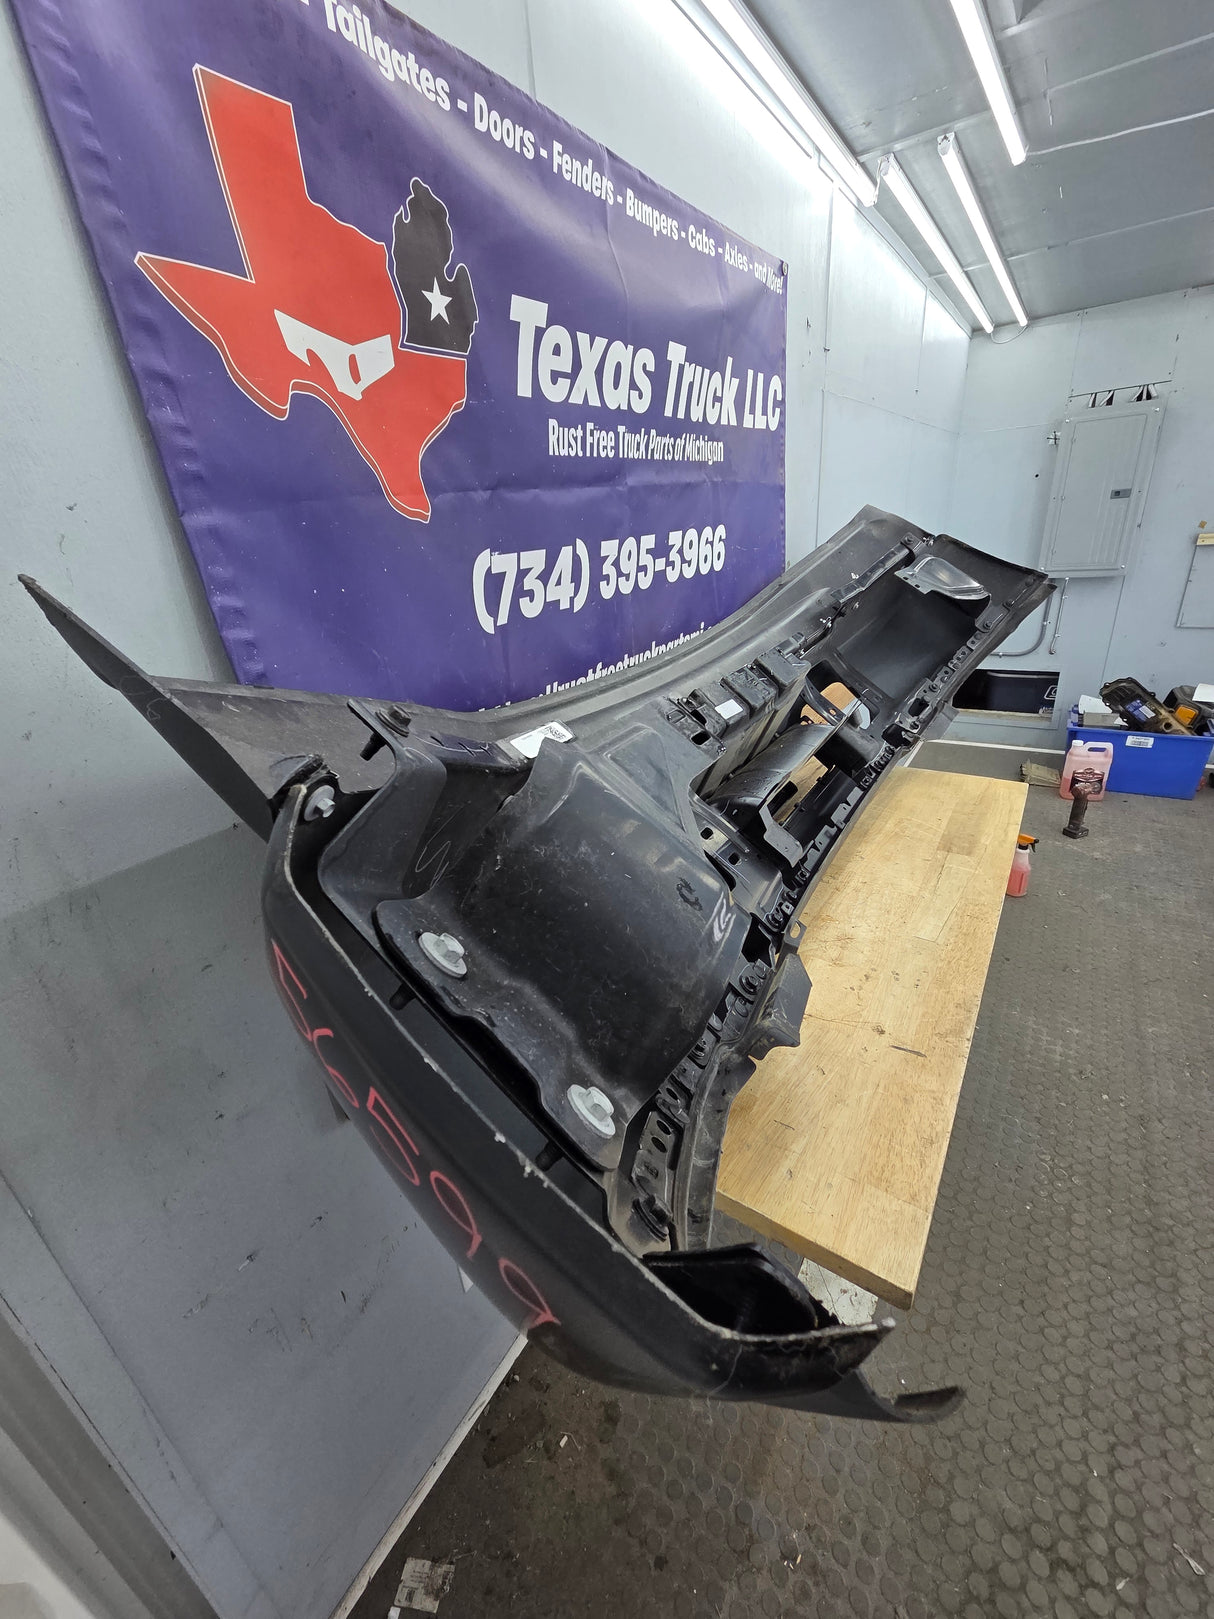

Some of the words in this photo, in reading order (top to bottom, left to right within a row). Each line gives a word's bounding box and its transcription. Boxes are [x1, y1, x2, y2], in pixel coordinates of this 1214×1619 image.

[323, 0, 450, 112] Tailgates
[474, 92, 535, 160] Doors
[553, 140, 614, 206] Fenders
[626, 187, 679, 241] Bumpers
[688, 224, 716, 257] Cabs
[724, 241, 749, 273] Axles
[754, 261, 767, 284] and
[767, 266, 784, 295] More!
[510, 294, 655, 414] Texas
[664, 341, 739, 427] Truck
[742, 368, 782, 431] LLC
[548, 418, 583, 457] Rust
[586, 422, 615, 458] Free
[617, 425, 648, 460] Truck
[647, 428, 674, 461] Parts
[674, 432, 687, 462] of
[684, 433, 724, 466] Michigan
[472, 537, 590, 635] (734)
[599, 524, 726, 600] 395-3966
